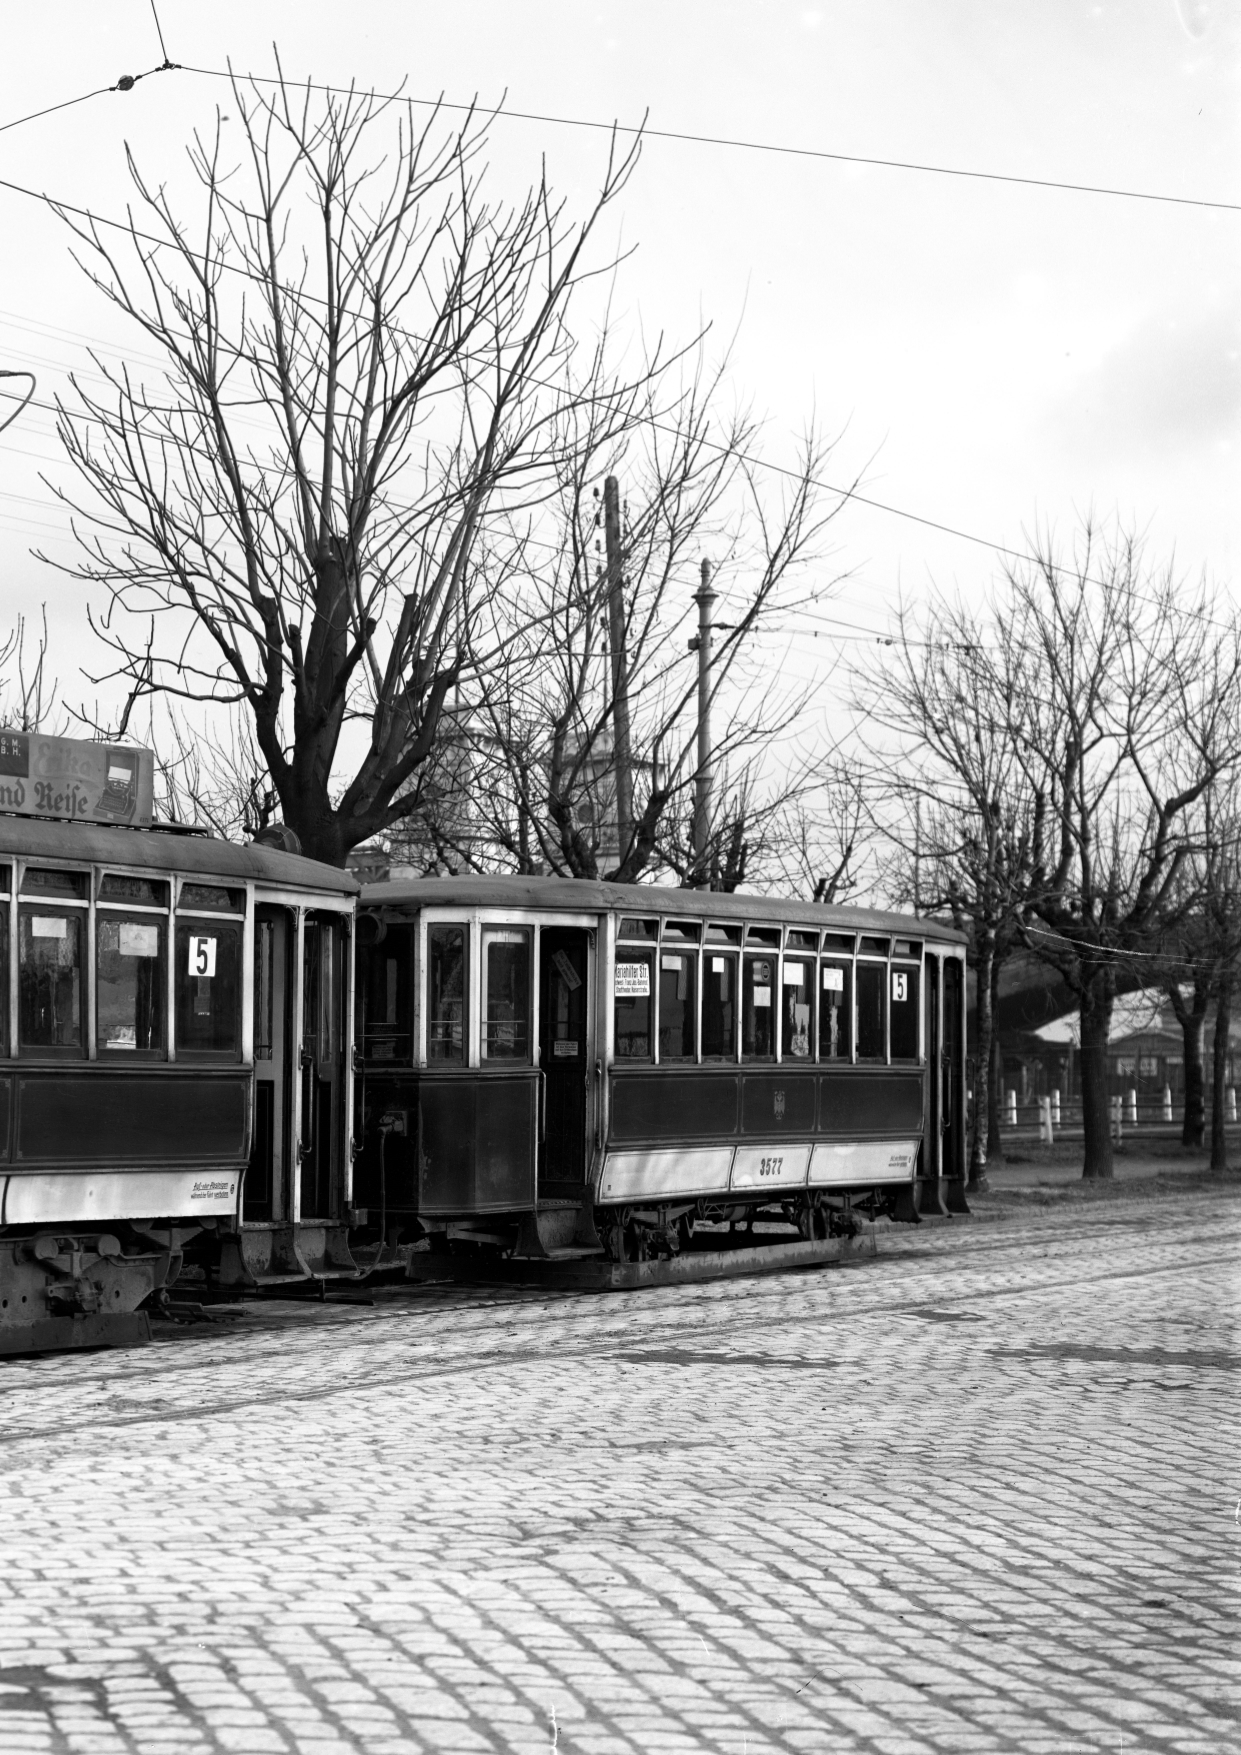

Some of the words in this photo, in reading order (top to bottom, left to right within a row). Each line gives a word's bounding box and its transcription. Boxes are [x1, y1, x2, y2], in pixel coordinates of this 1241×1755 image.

[0, 738, 9, 747] G.
[12, 739, 21, 748] M.
[0, 746, 9, 755] B.
[12, 748, 21, 757] H.
[196, 938, 208, 975] 5
[615, 965, 638, 978] ariahilfer
[897, 973, 904, 1000] 5
[760, 1157, 784, 1176] 3577
